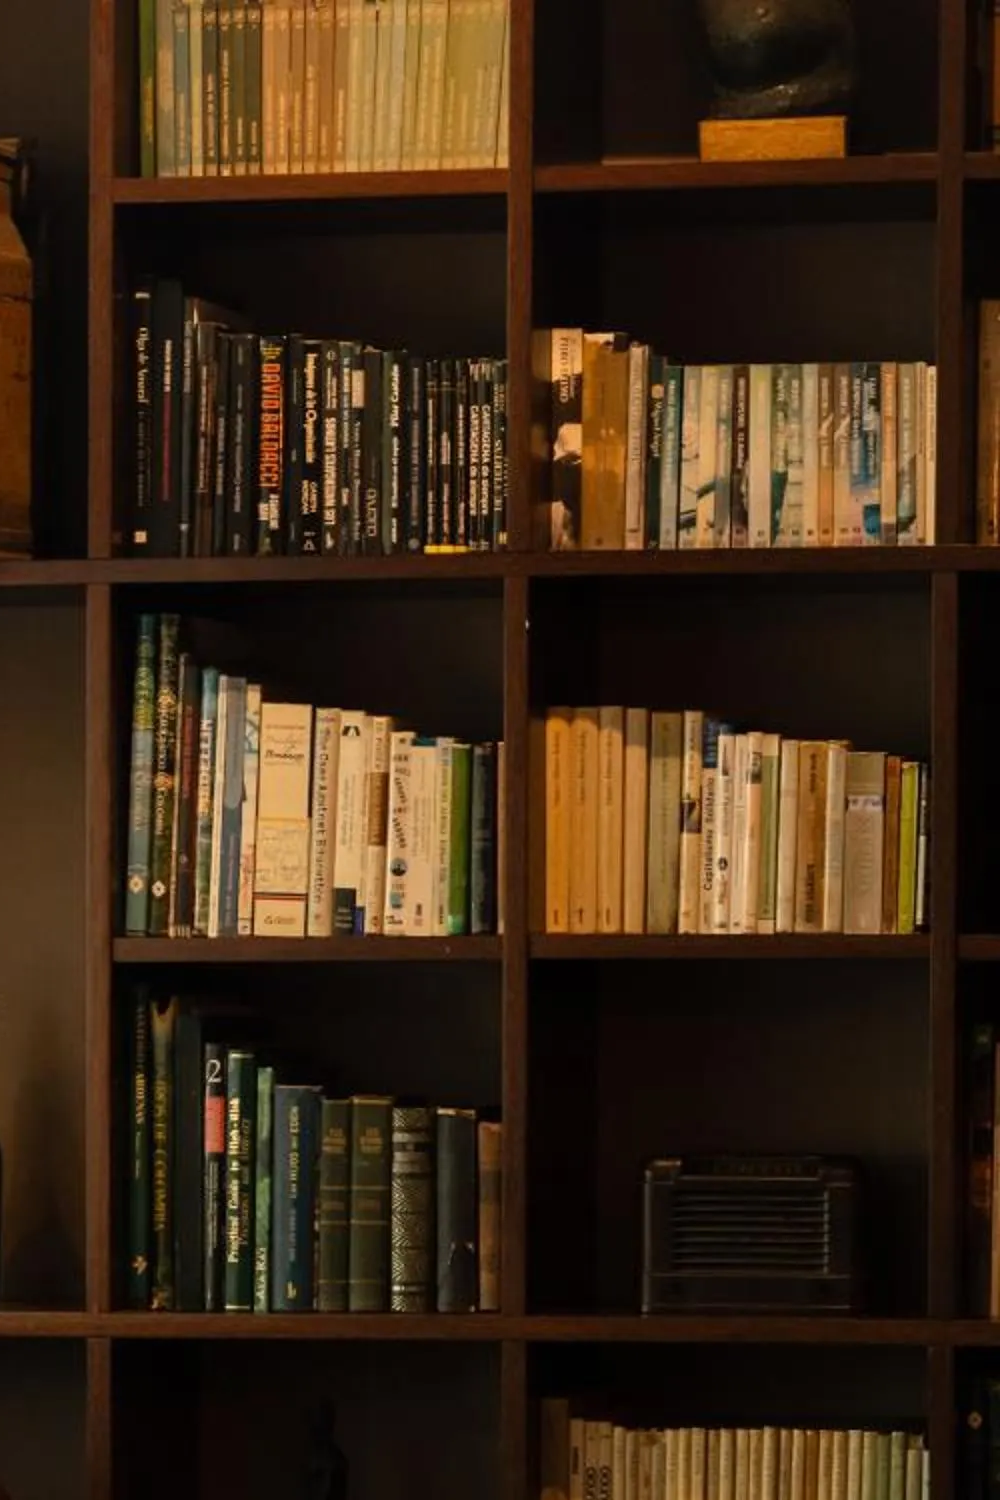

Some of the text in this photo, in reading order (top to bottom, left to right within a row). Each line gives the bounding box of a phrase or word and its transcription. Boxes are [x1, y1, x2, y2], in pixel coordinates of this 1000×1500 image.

[260, 363, 281, 408] DAVID
[260, 413, 281, 487] BALDACCI
[470, 404, 479, 464] CARTAGENA
[481, 404, 490, 464] CARTAGENA
[703, 777, 714, 891] Capitalismo Solidario
[206, 1059, 222, 1084] 2
